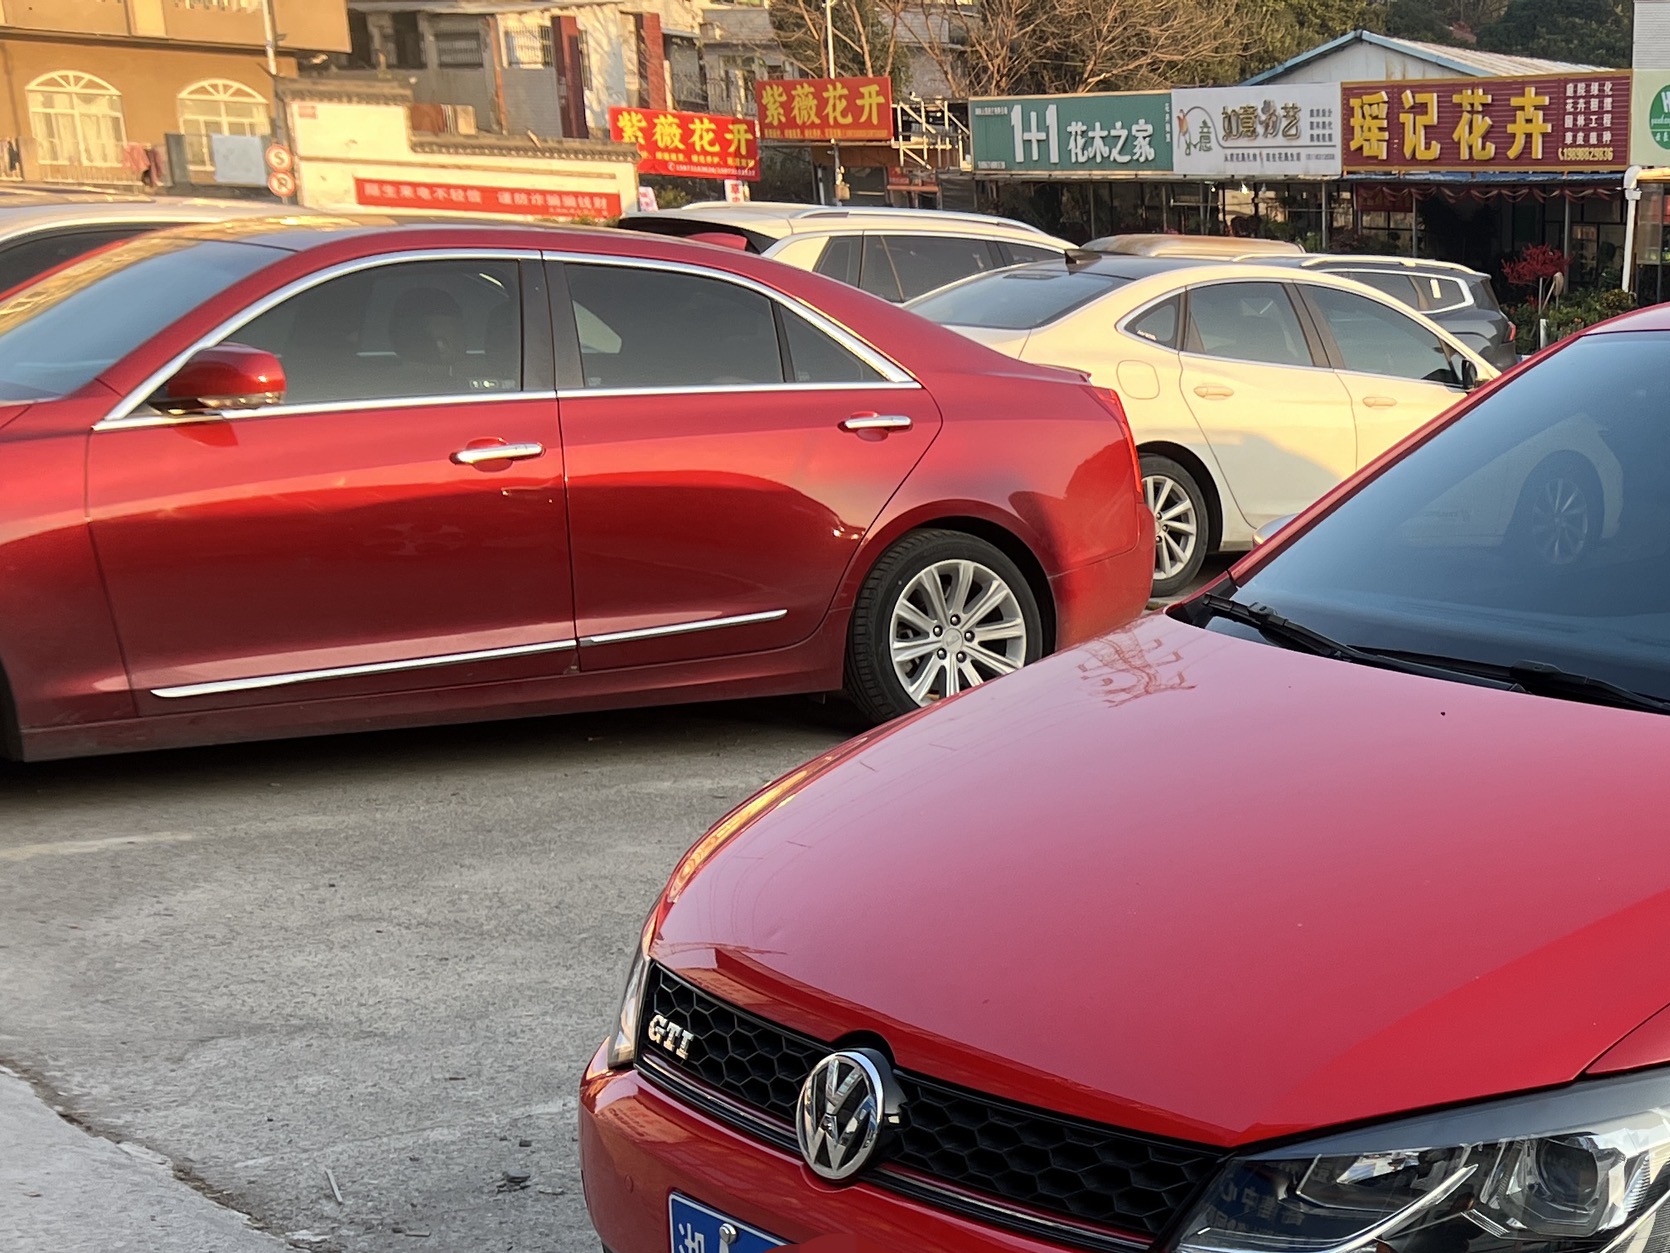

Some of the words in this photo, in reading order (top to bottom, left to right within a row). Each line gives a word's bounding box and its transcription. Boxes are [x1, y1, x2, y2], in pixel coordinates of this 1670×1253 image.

[761, 82, 886, 127] 紫薇花开
[1349, 86, 1552, 160] 瑶记花卉
[616, 110, 754, 156] 紫薇花开
[1011, 104, 1060, 164] 1+1
[1066, 118, 1156, 164] 花木之家
[648, 1014, 694, 1061] GTI
